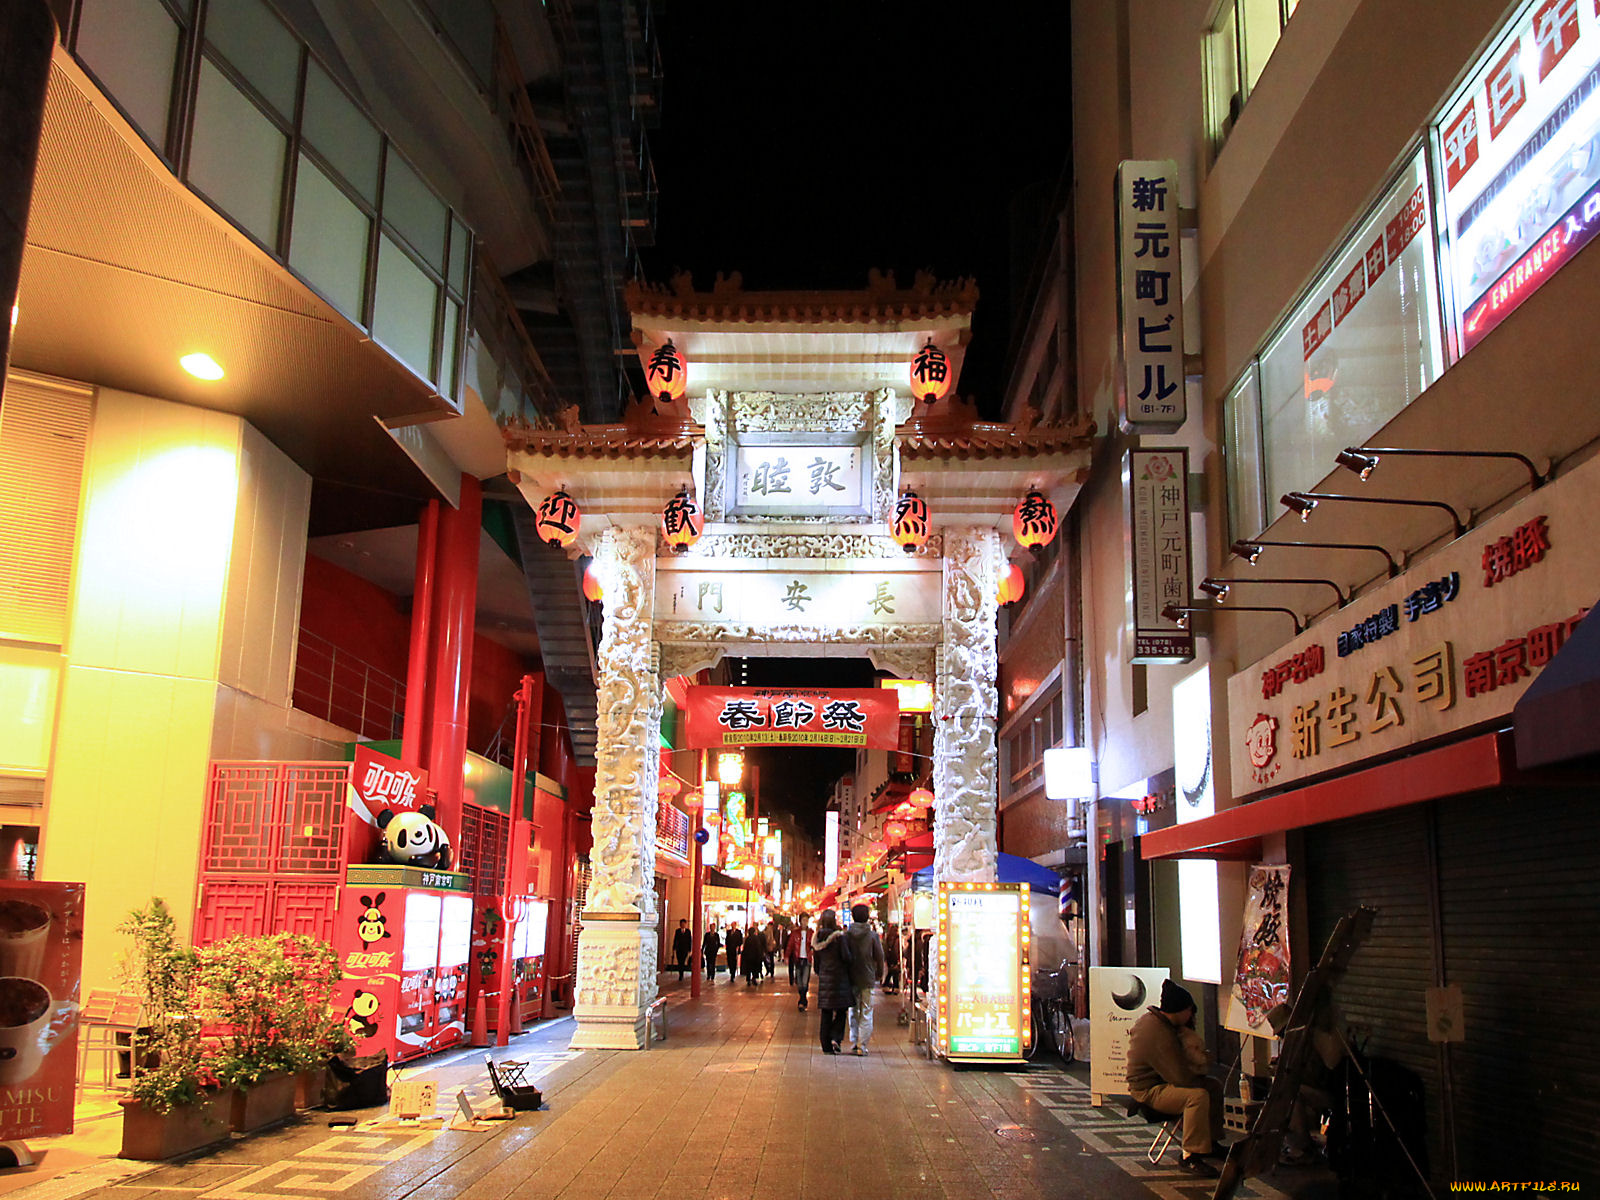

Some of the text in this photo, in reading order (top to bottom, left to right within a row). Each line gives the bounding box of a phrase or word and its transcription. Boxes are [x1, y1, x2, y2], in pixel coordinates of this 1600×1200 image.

[1132, 177, 1178, 400] 新元町ビル
[1492, 229, 1561, 311] ENTRANCE
[648, 345, 682, 382] 寿
[913, 348, 947, 385] 福
[537, 496, 577, 535] 迎
[894, 497, 929, 537] 烈
[1159, 484, 1184, 614] 神戸元町歯
[1261, 644, 1325, 699] 神戸名物
[1482, 515, 1552, 587] 焼豚
[1137, 646, 1191, 655] 335-2122
[1152, 638, 1172, 647] (078)
[1290, 640, 1457, 759] 新生公司
[362, 761, 421, 809] 可口可乐
